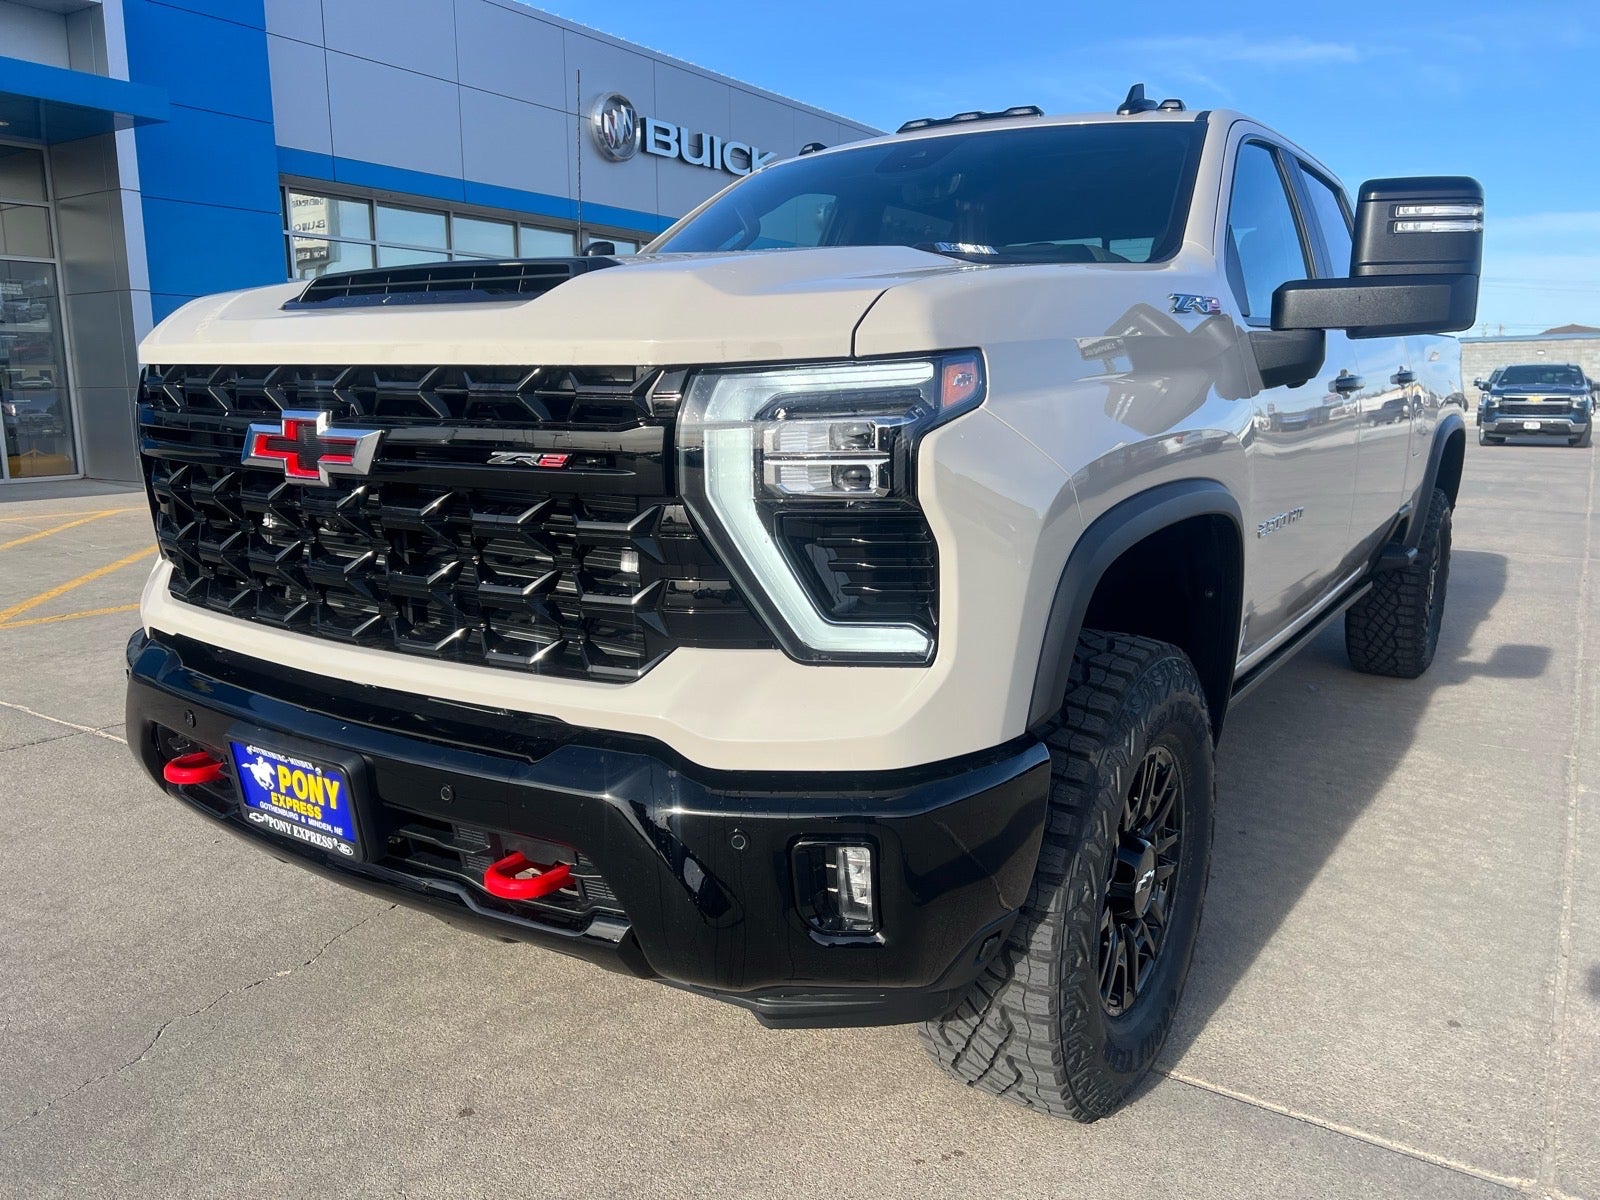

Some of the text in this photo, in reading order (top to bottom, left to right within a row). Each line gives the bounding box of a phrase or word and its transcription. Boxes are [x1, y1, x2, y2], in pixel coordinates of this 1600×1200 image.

[642, 117, 778, 176] BUICK
[1167, 293, 1222, 315] ZR2
[486, 451, 570, 468] ZR2
[277, 764, 340, 810] PONY
[259, 800, 343, 836] GOTHENBURG & MINDEN, NE
[271, 791, 322, 820] EXPRESS
[268, 816, 333, 850] PONY EXPRESS
